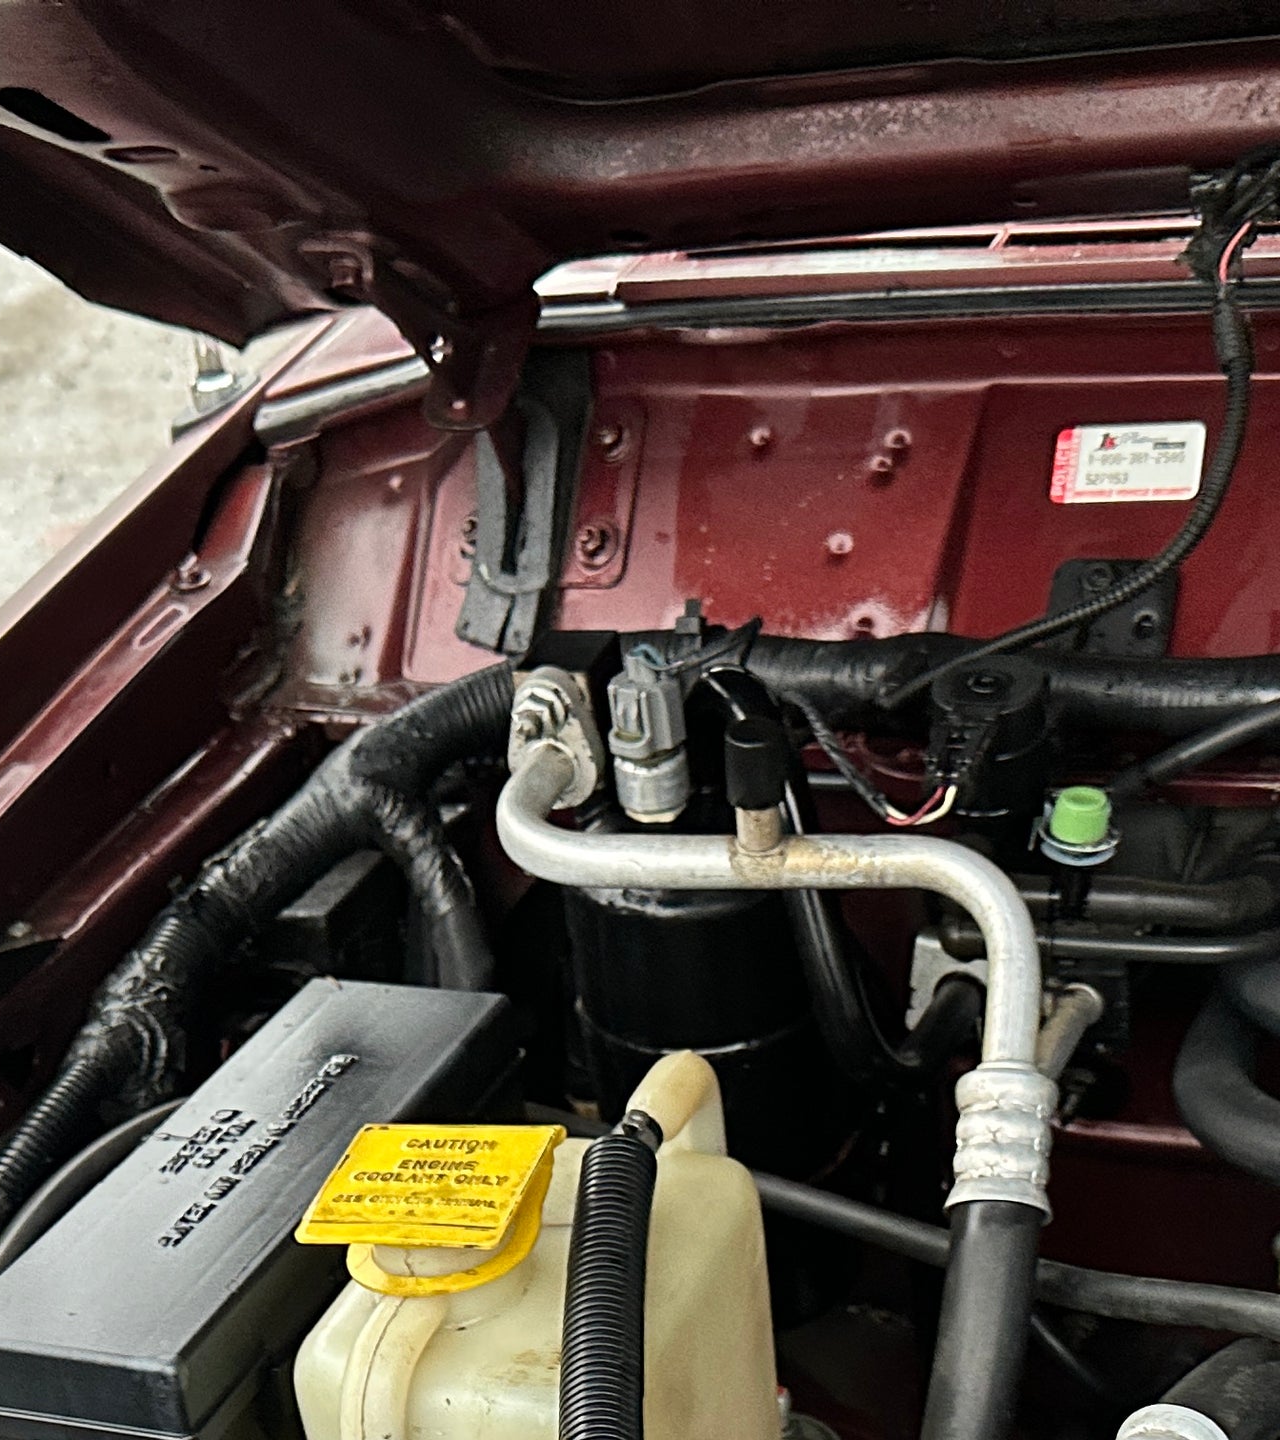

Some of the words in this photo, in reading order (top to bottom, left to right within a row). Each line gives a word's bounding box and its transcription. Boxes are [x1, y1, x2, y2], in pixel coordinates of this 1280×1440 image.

[406, 1138, 499, 1154] CAUTION
[398, 1159, 479, 1171] ENGINE
[354, 1171, 445, 1184] COOLANT
[453, 1174, 510, 1187] ONLY
